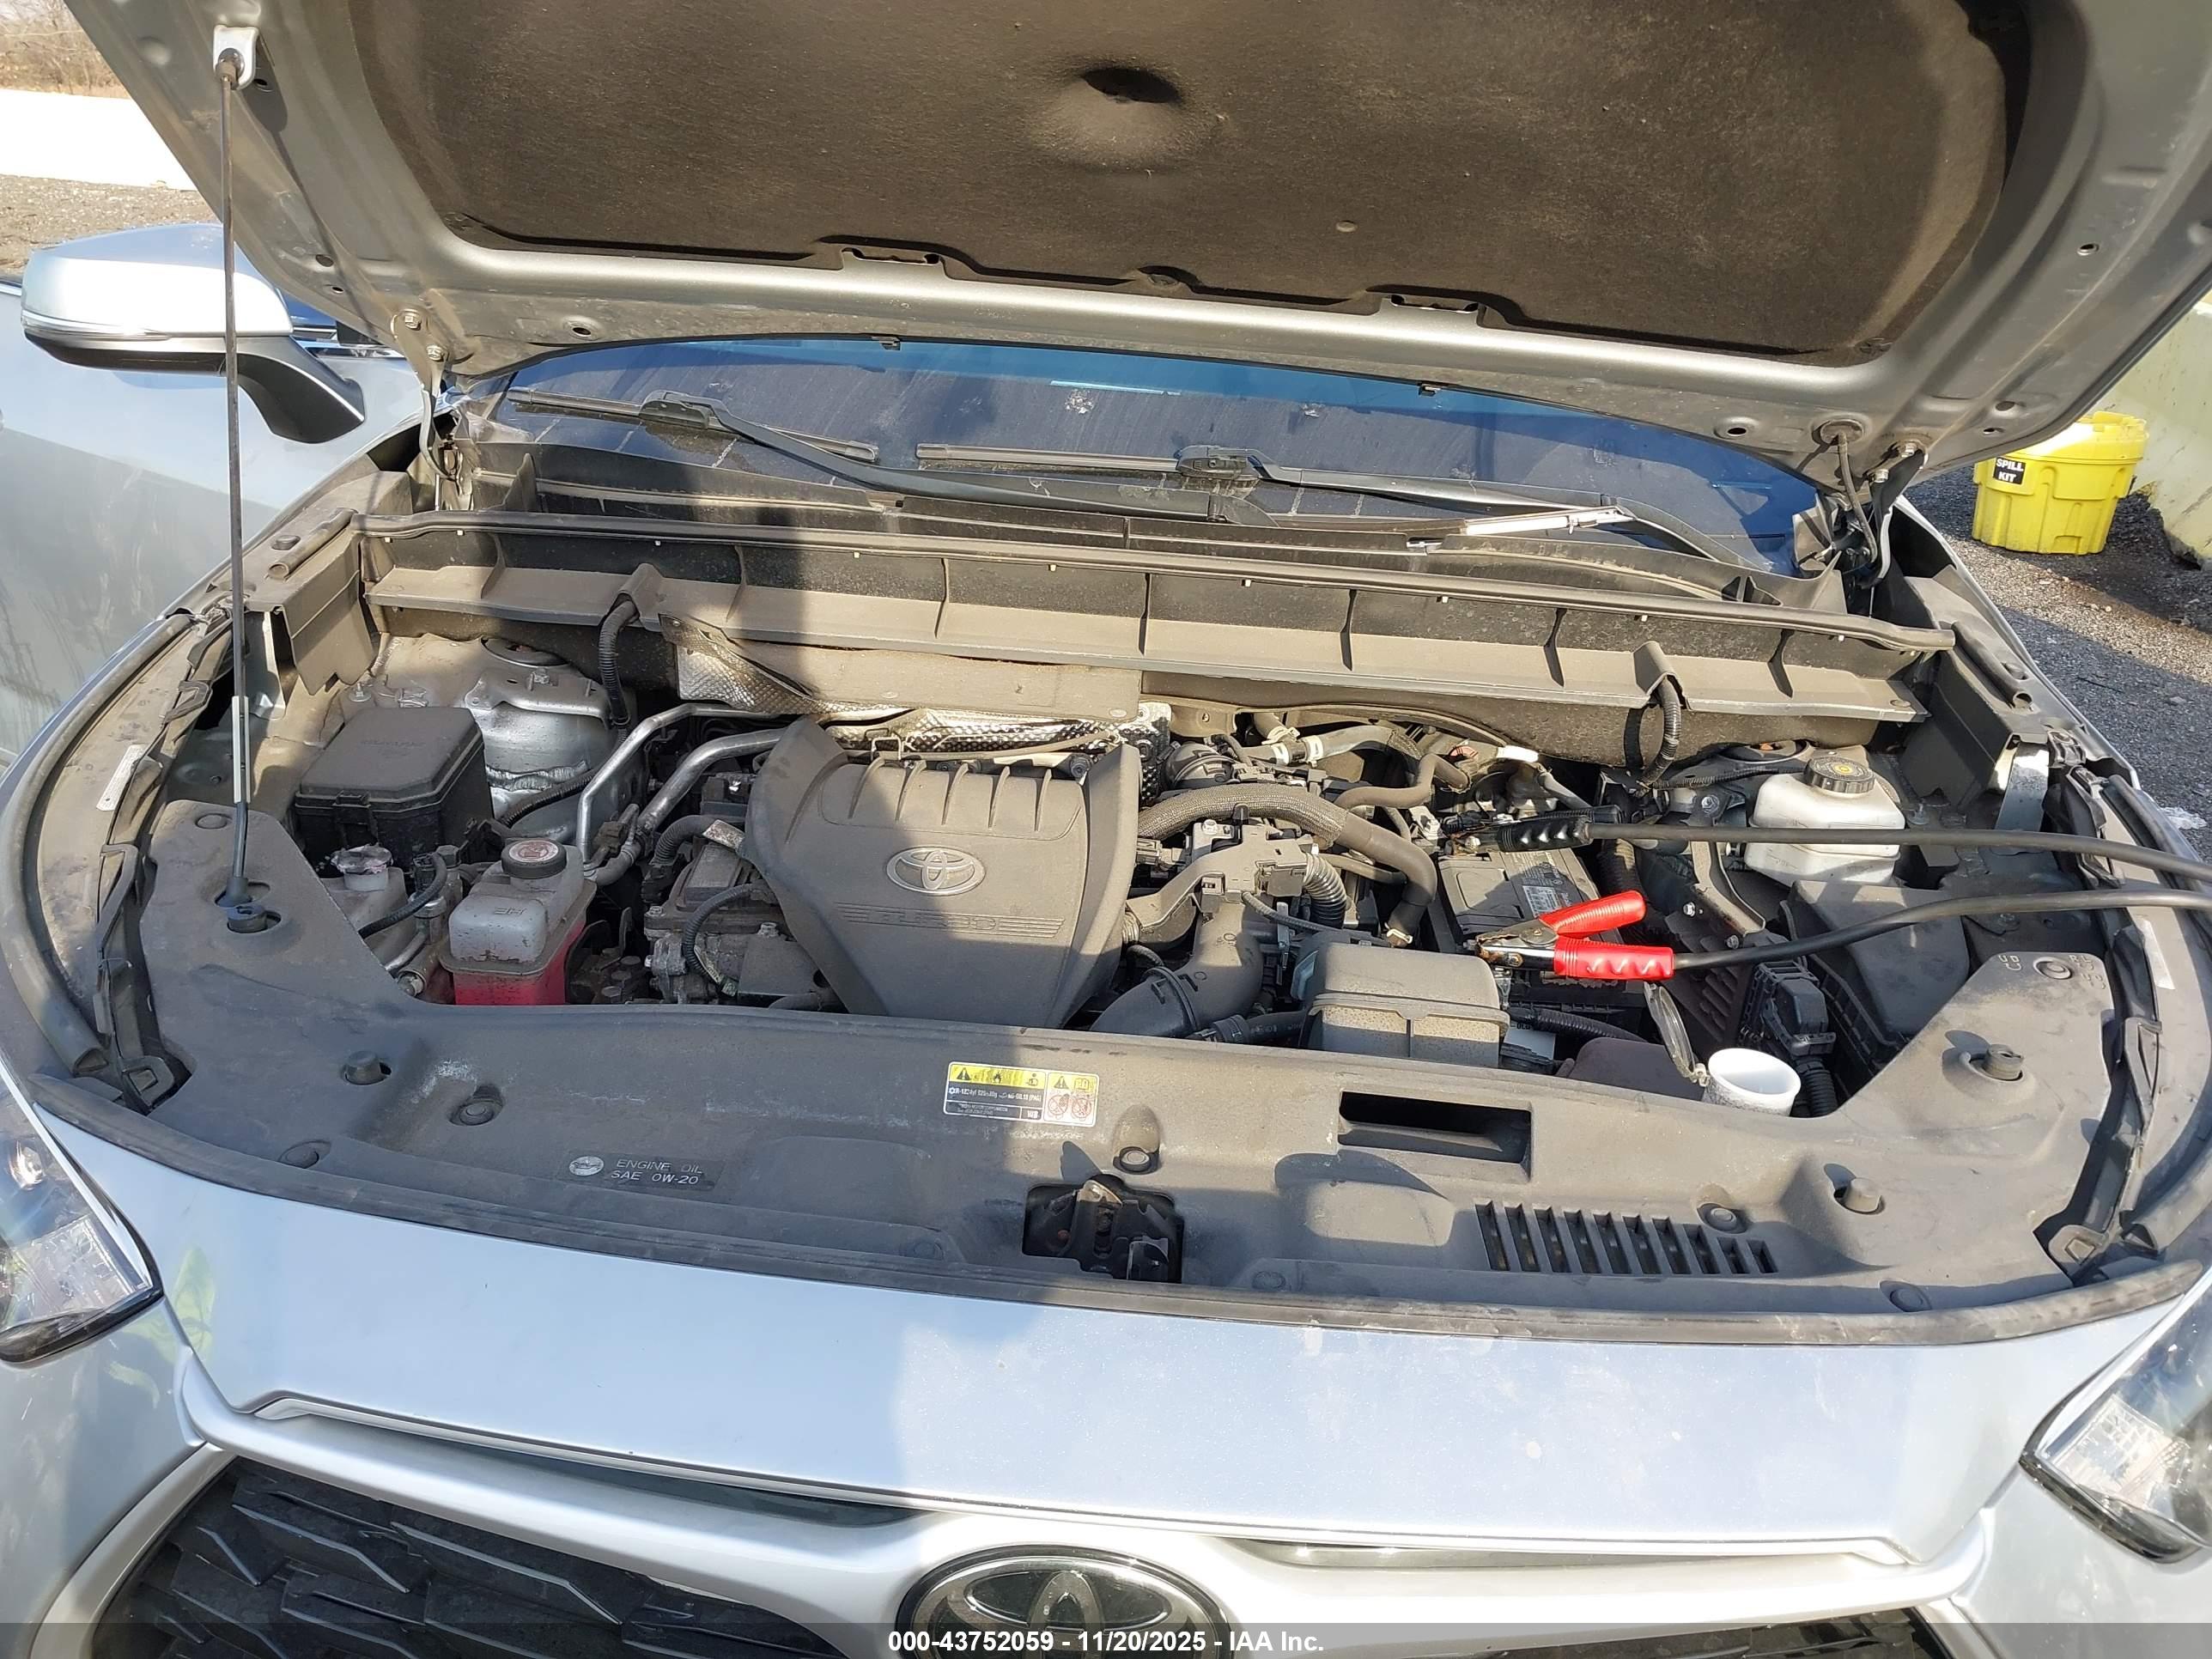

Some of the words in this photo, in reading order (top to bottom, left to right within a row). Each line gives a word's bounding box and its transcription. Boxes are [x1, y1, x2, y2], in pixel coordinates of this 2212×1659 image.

[1996, 459, 2023, 471] SPILL
[1998, 471, 2016, 483] KIT
[617, 1159, 672, 1171] ENGINE
[681, 1164, 704, 1174] OIL
[611, 1170, 643, 1181] SAE
[652, 1174, 699, 1185] 0W-20
